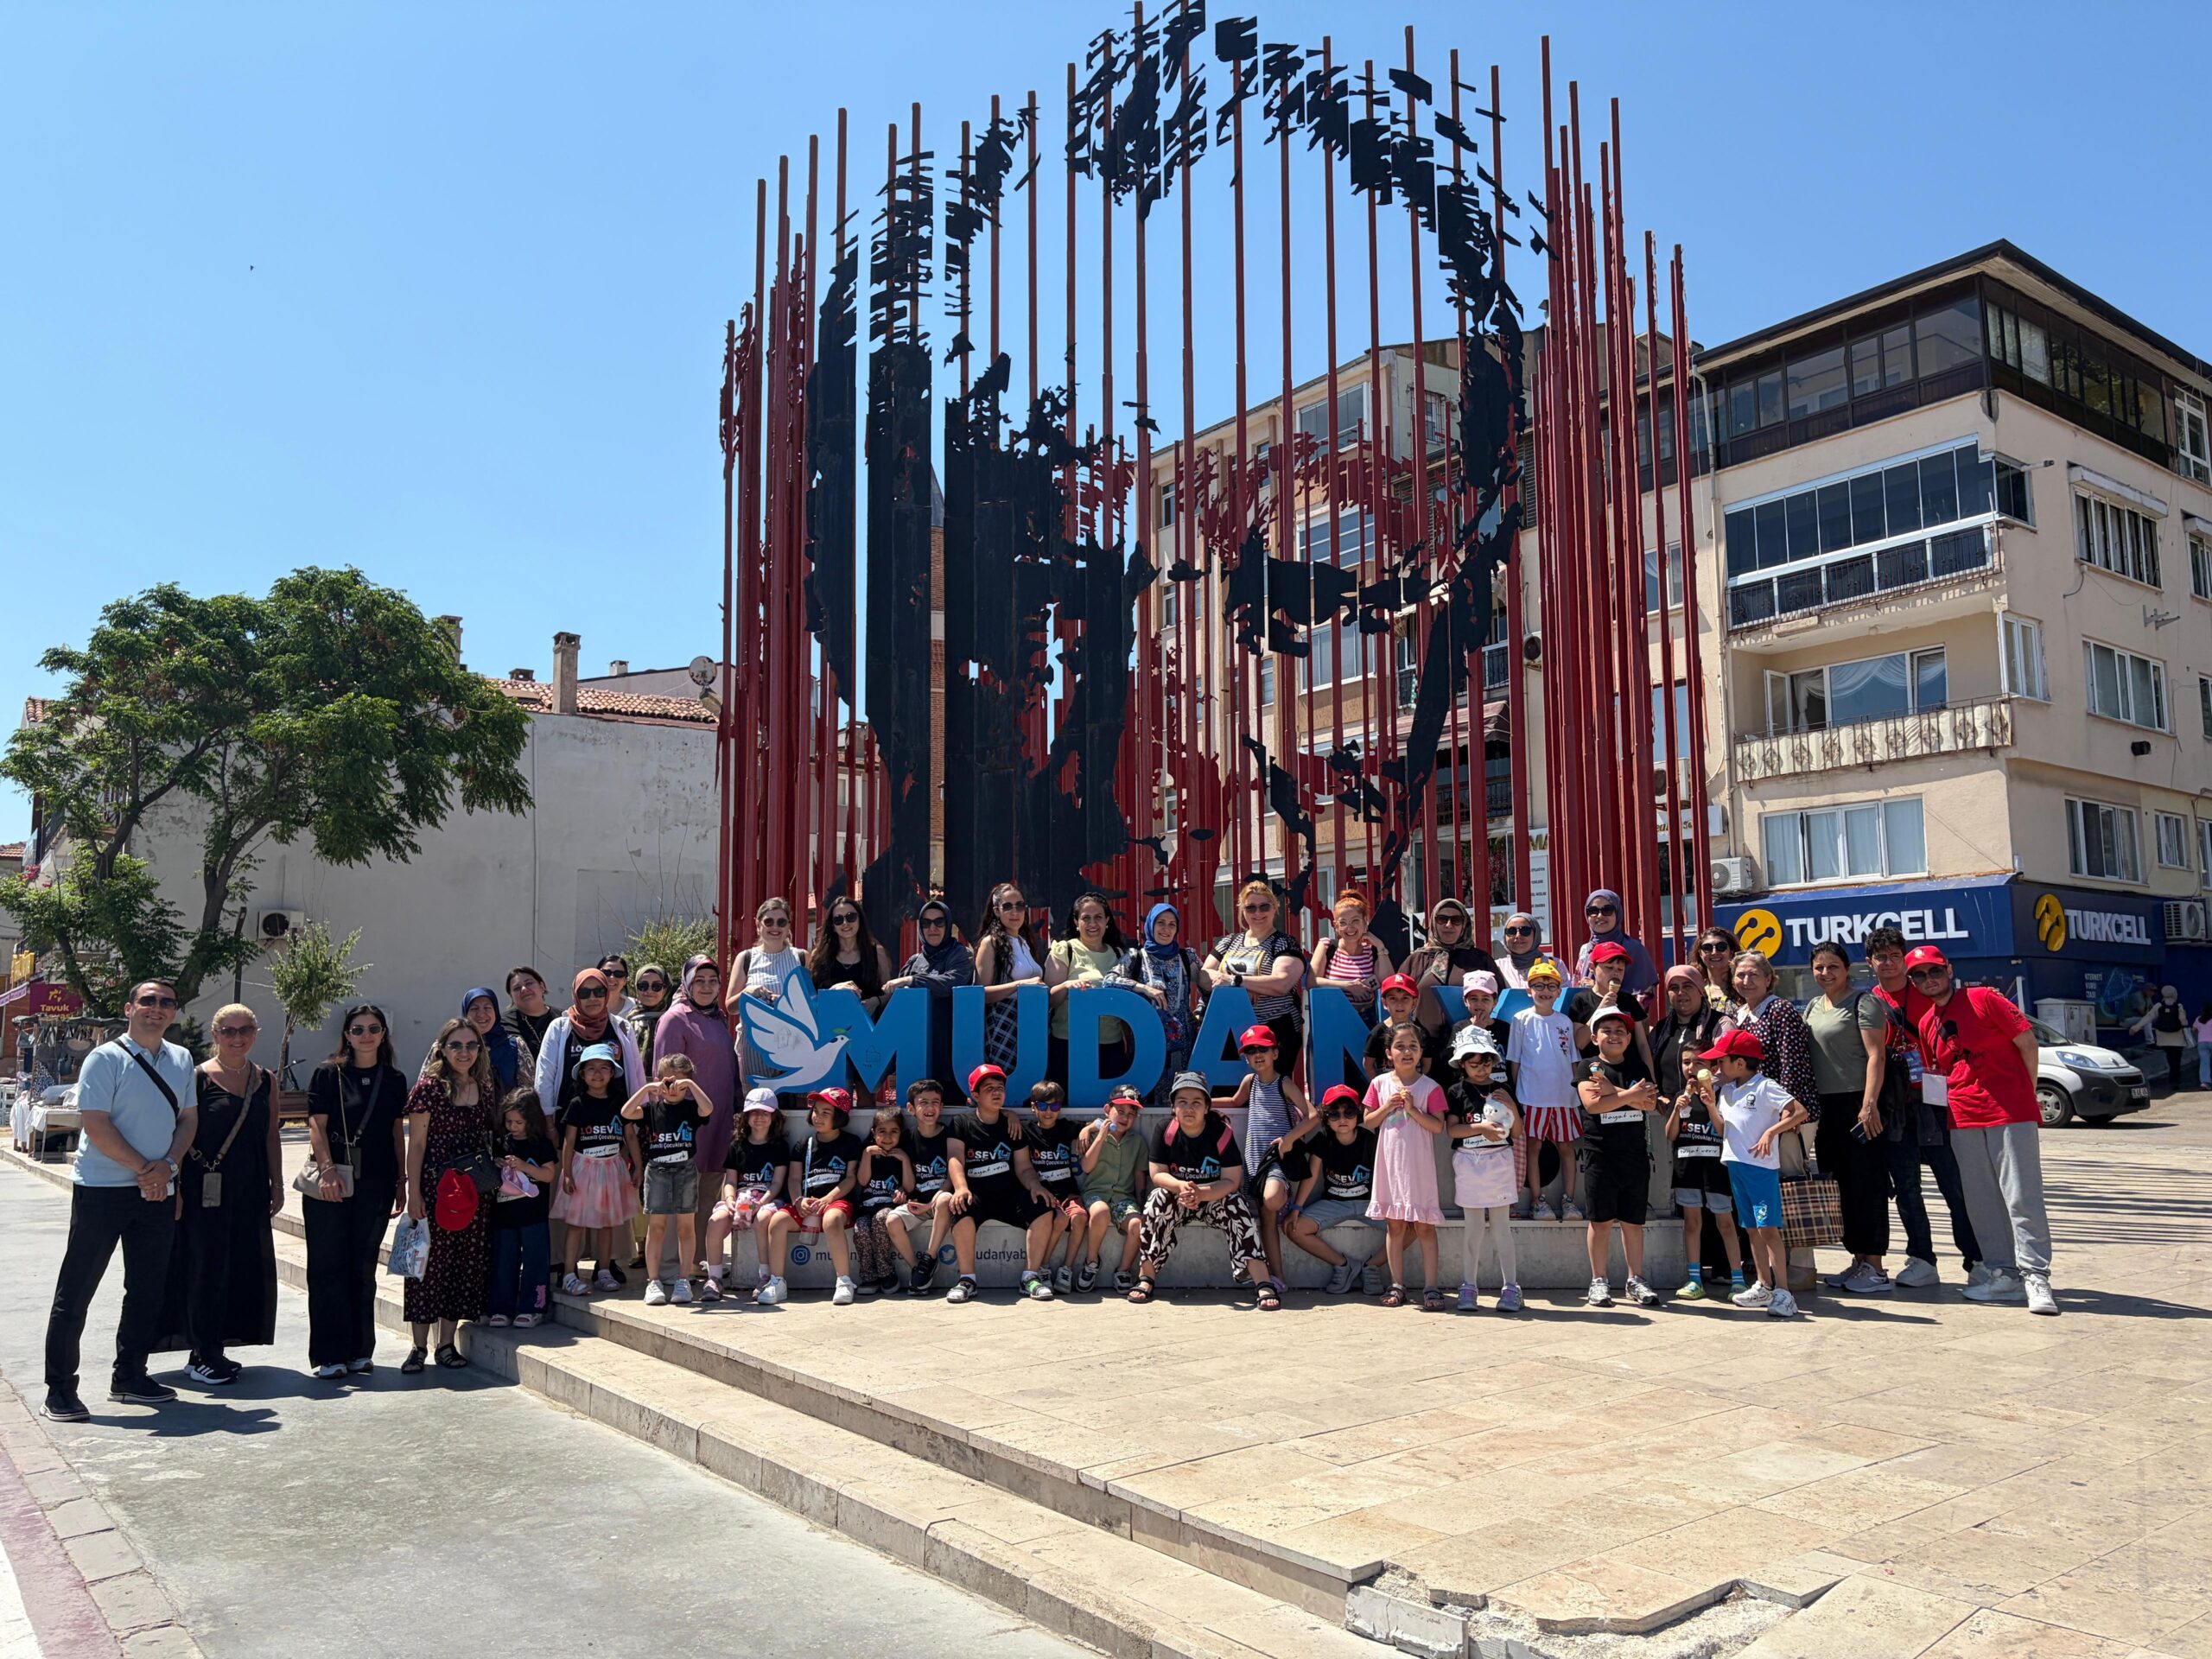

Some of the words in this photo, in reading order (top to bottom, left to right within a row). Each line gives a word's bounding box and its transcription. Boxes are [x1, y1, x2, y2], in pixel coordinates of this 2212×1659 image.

[1785, 908, 1969, 947] TURKCELL
[2064, 908, 2152, 945] TURKCELL
[1602, 1112, 1627, 1122] Hayat
[1681, 1122, 1710, 1135] ÖSEV
